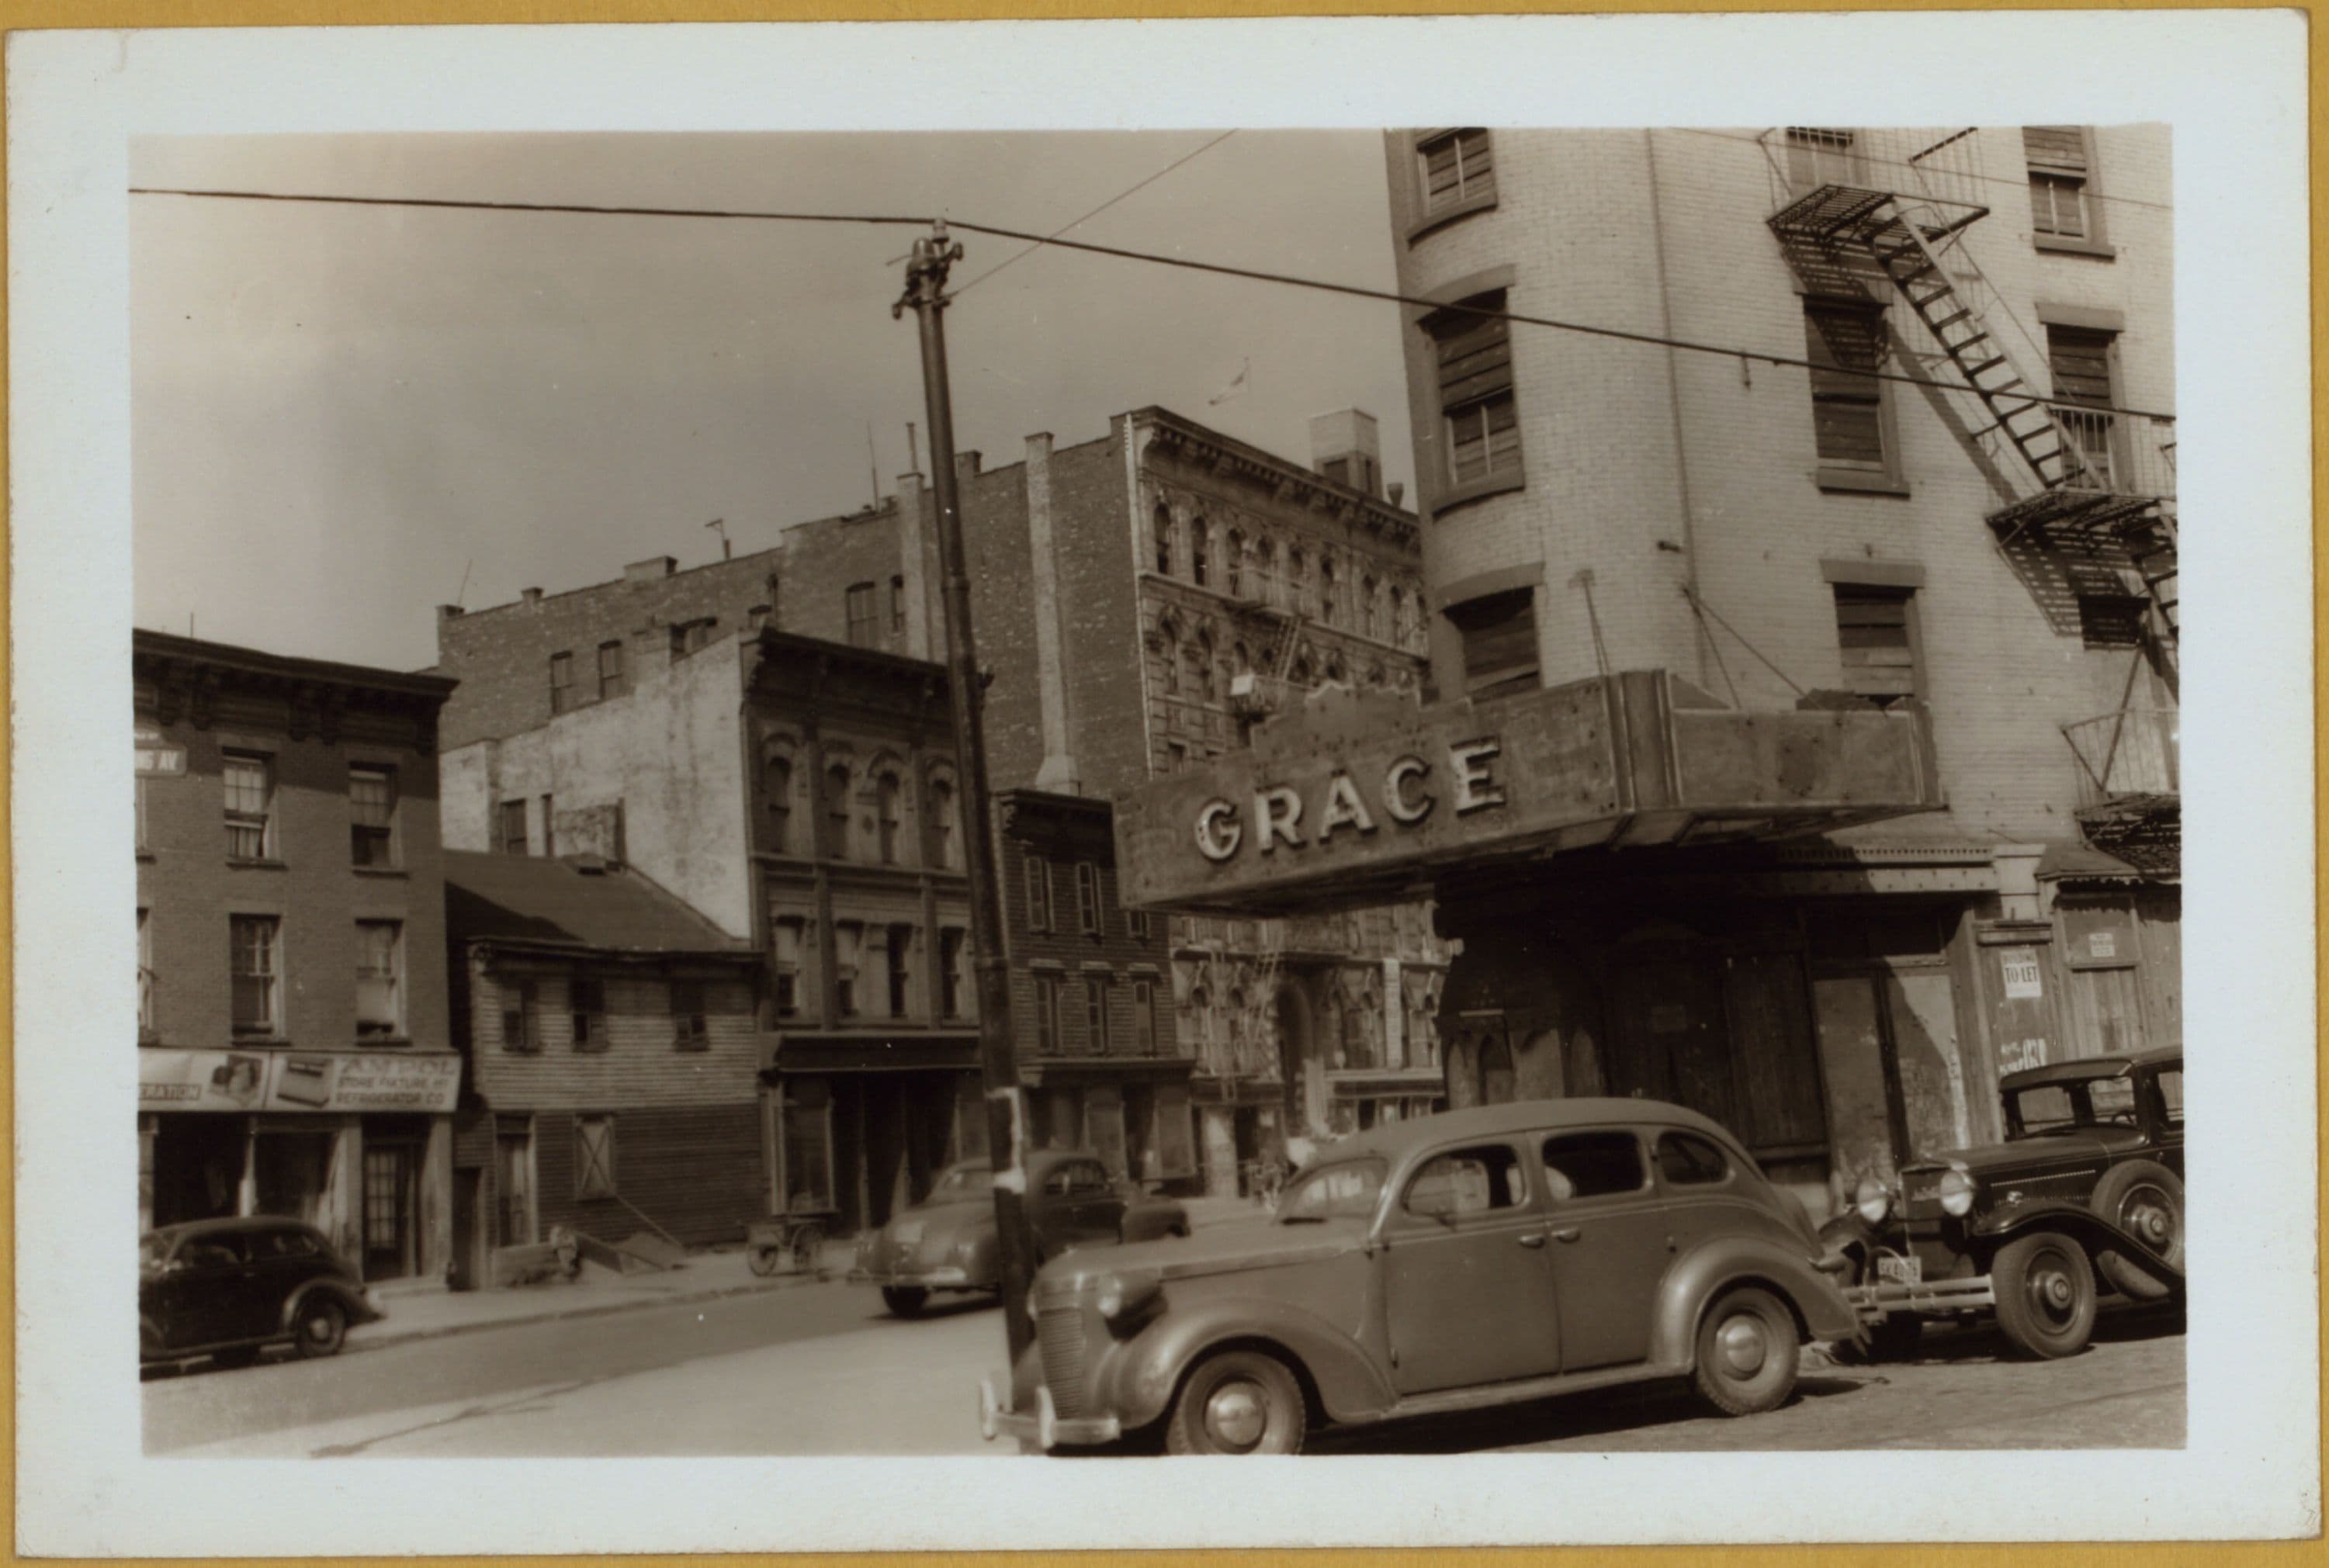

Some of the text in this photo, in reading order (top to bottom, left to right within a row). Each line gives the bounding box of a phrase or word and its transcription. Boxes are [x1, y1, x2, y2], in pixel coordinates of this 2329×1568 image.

[1194, 736, 1505, 861] GRACE
[2005, 967, 2038, 983] TO LET
[337, 1076, 374, 1088] STORE
[335, 1092, 422, 1105] REFRIGERATOR
